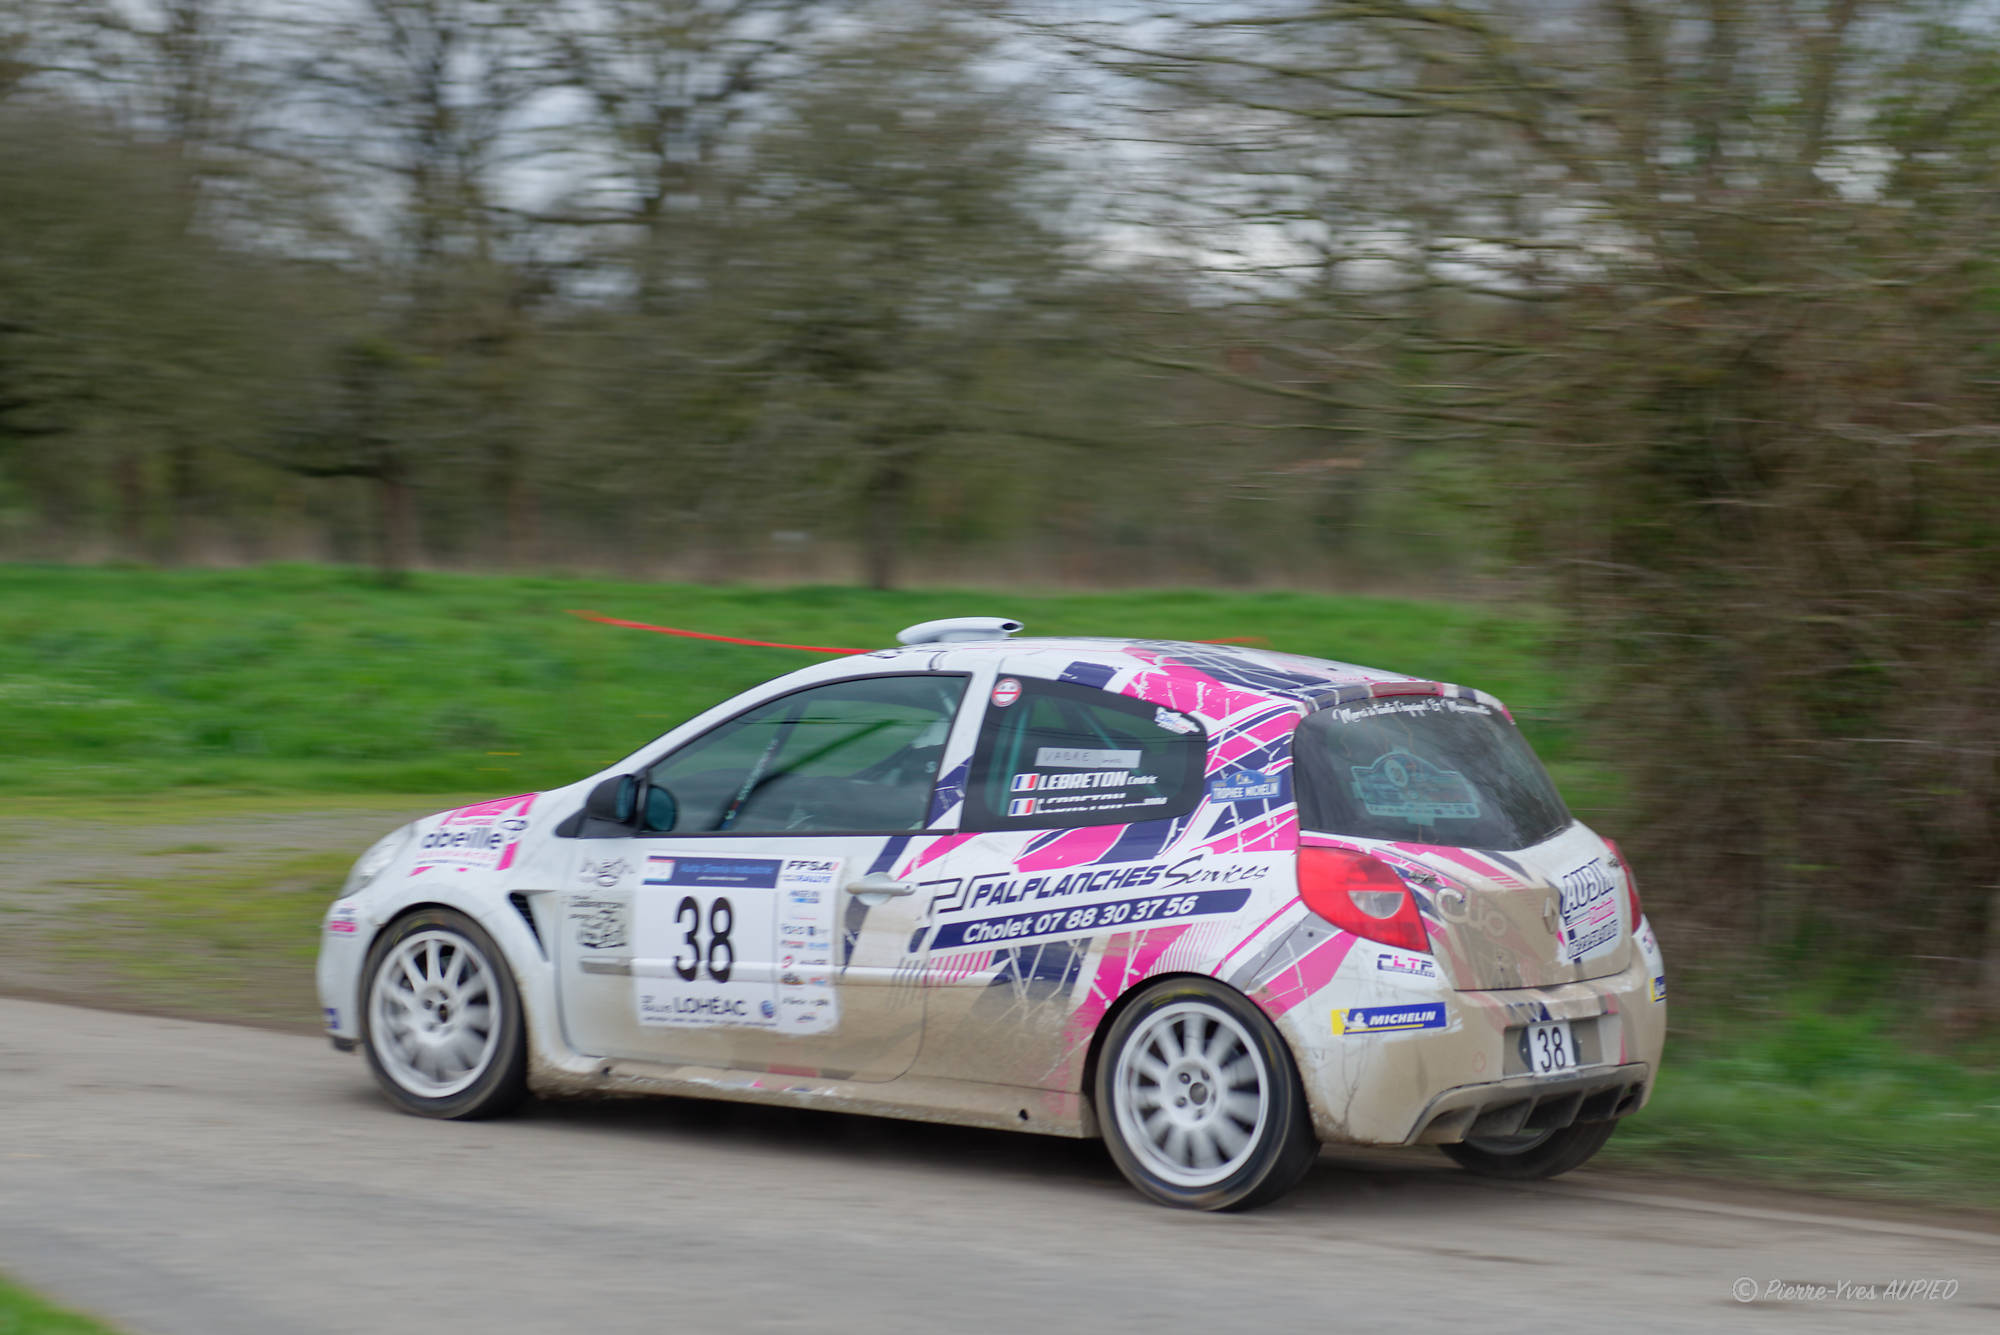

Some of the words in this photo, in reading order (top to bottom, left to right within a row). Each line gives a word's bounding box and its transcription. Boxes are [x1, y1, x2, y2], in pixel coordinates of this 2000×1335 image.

[1037, 770, 1129, 791] LEBRETON
[786, 860, 832, 871] FFSA
[971, 864, 1168, 908] PALPLANCHES
[1161, 853, 1270, 890] Services
[962, 916, 1034, 944] Cholet
[1034, 912, 1063, 934] 07
[1065, 907, 1098, 929] 88
[1100, 903, 1130, 925] 30
[1132, 898, 1161, 921] 37
[1165, 894, 1199, 916] 56
[673, 895, 735, 984] 38
[673, 996, 747, 1016] LOHÉAC
[1369, 1010, 1437, 1026] MICHELIN
[1537, 1026, 1566, 1073] 38
